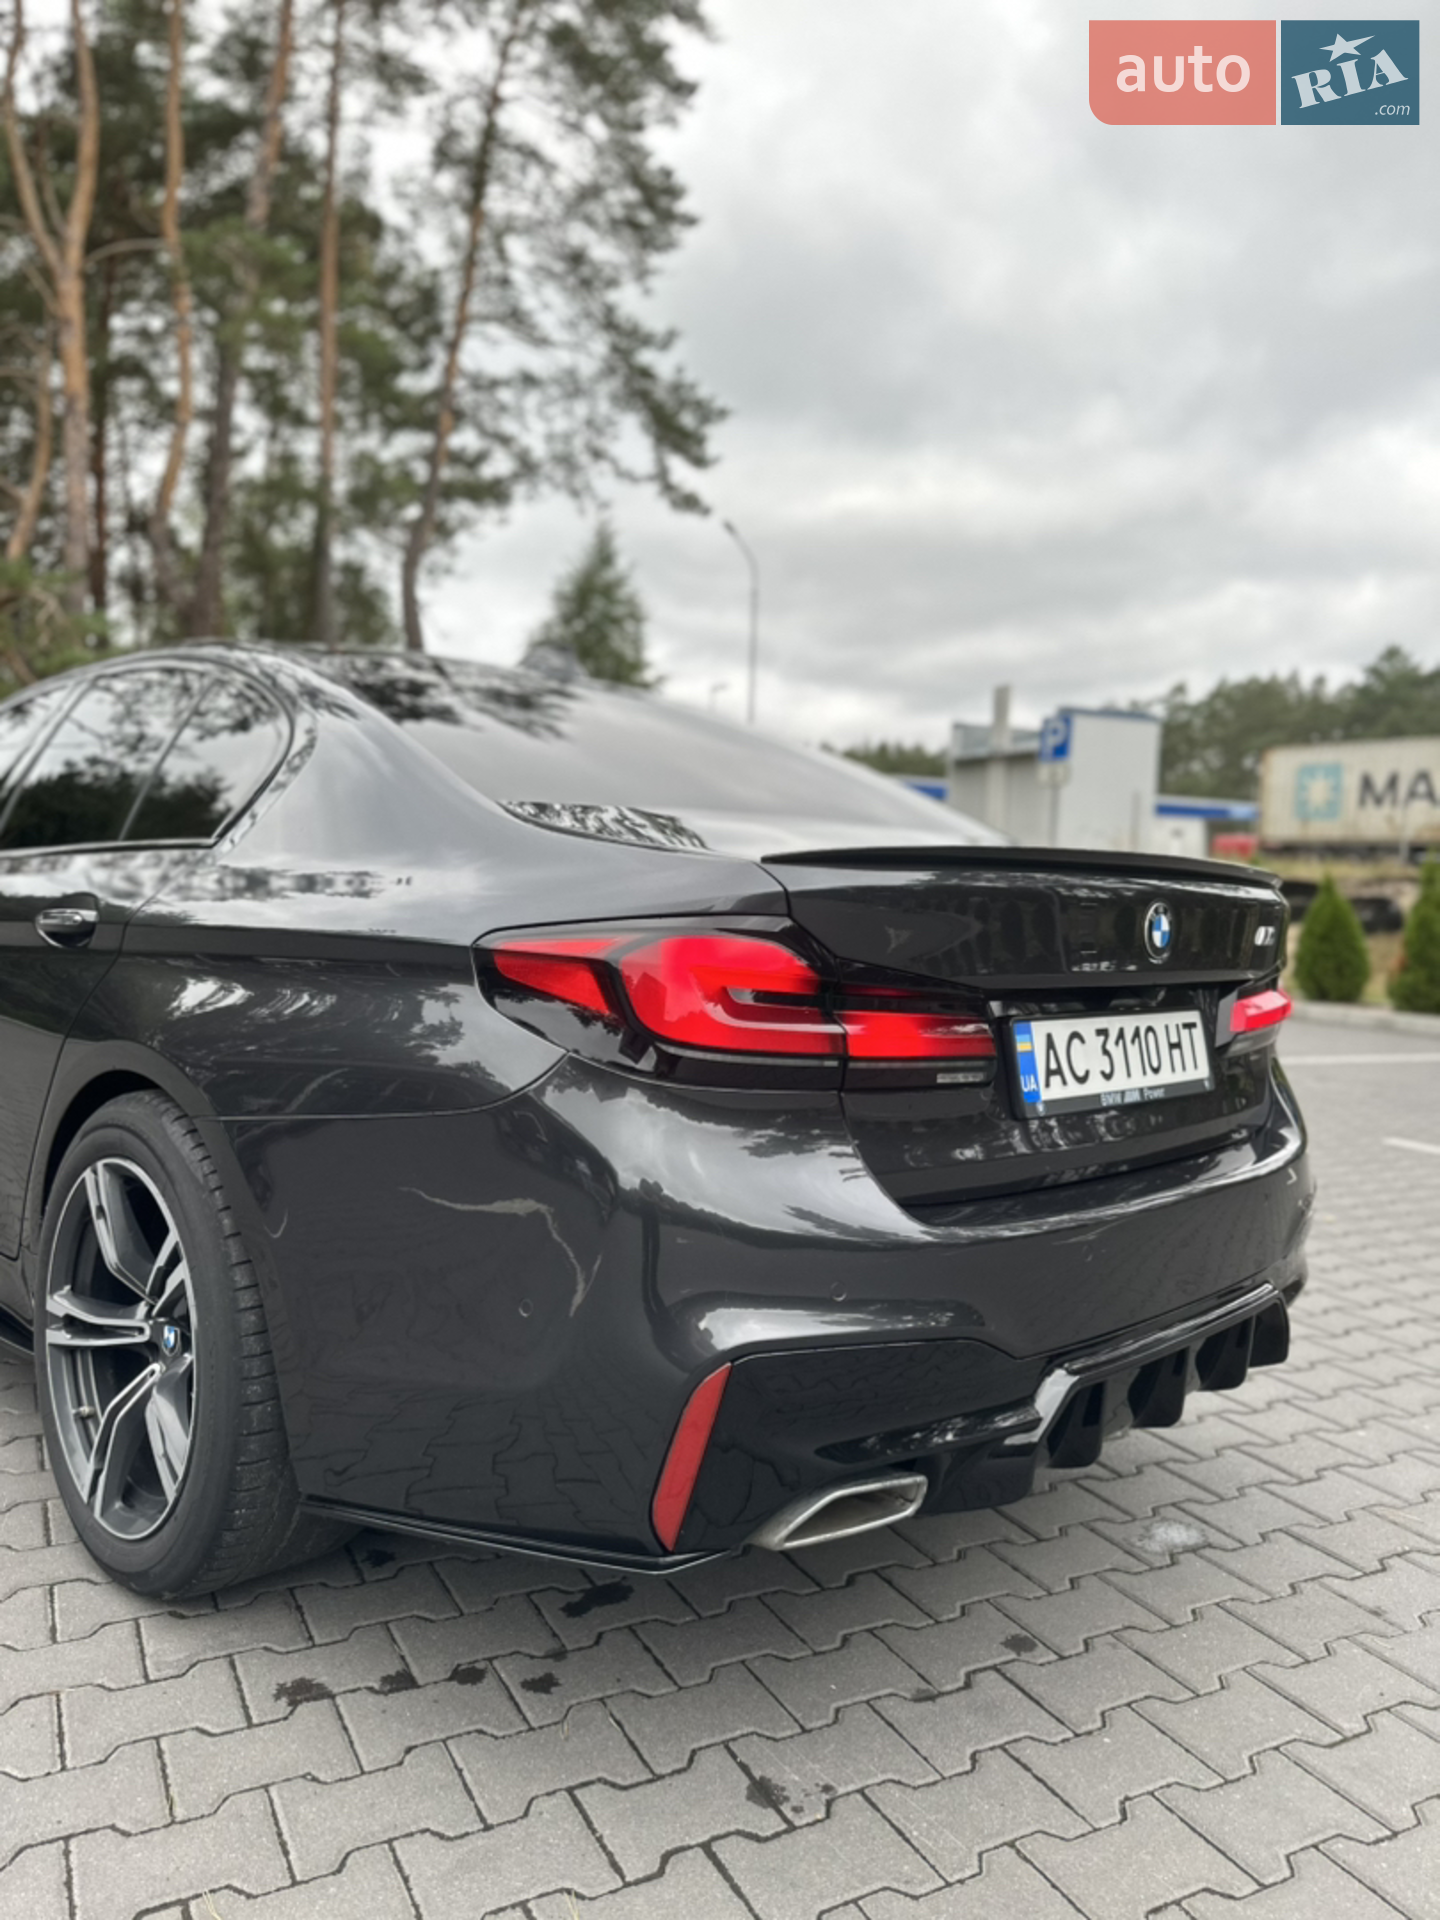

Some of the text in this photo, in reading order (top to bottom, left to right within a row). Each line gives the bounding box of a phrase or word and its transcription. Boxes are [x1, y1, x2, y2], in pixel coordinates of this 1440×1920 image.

[1045, 1022, 1198, 1088] AC 3110 HT
[1020, 1075, 1039, 1092] UA
